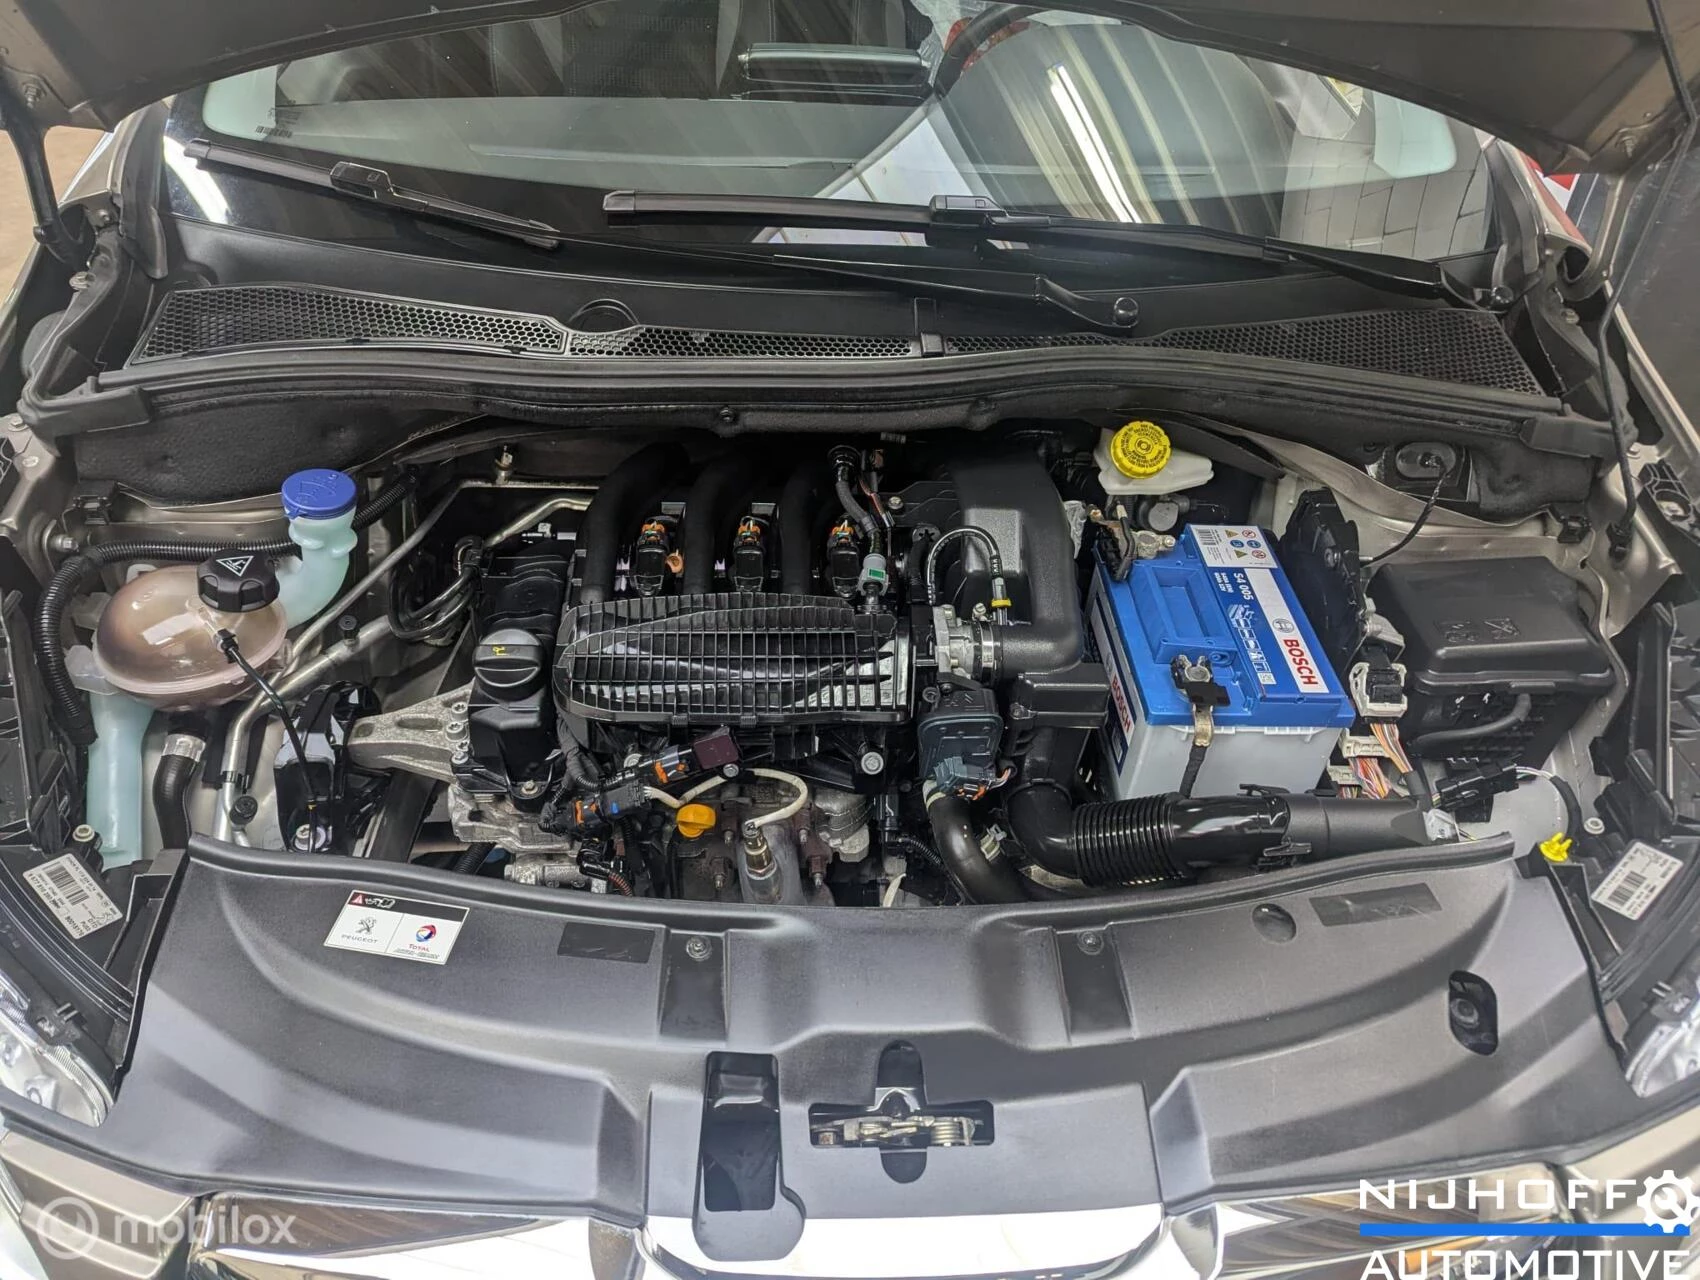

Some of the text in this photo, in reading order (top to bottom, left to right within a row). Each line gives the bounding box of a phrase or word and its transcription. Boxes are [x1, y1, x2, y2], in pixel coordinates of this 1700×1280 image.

[1233, 572, 1255, 601] S4 005
[1283, 638, 1319, 686] BOSCH
[1111, 673, 1132, 733] BOSCH
[341, 934, 378, 944] PEUGEOT
[408, 943, 431, 953] TOTAL
